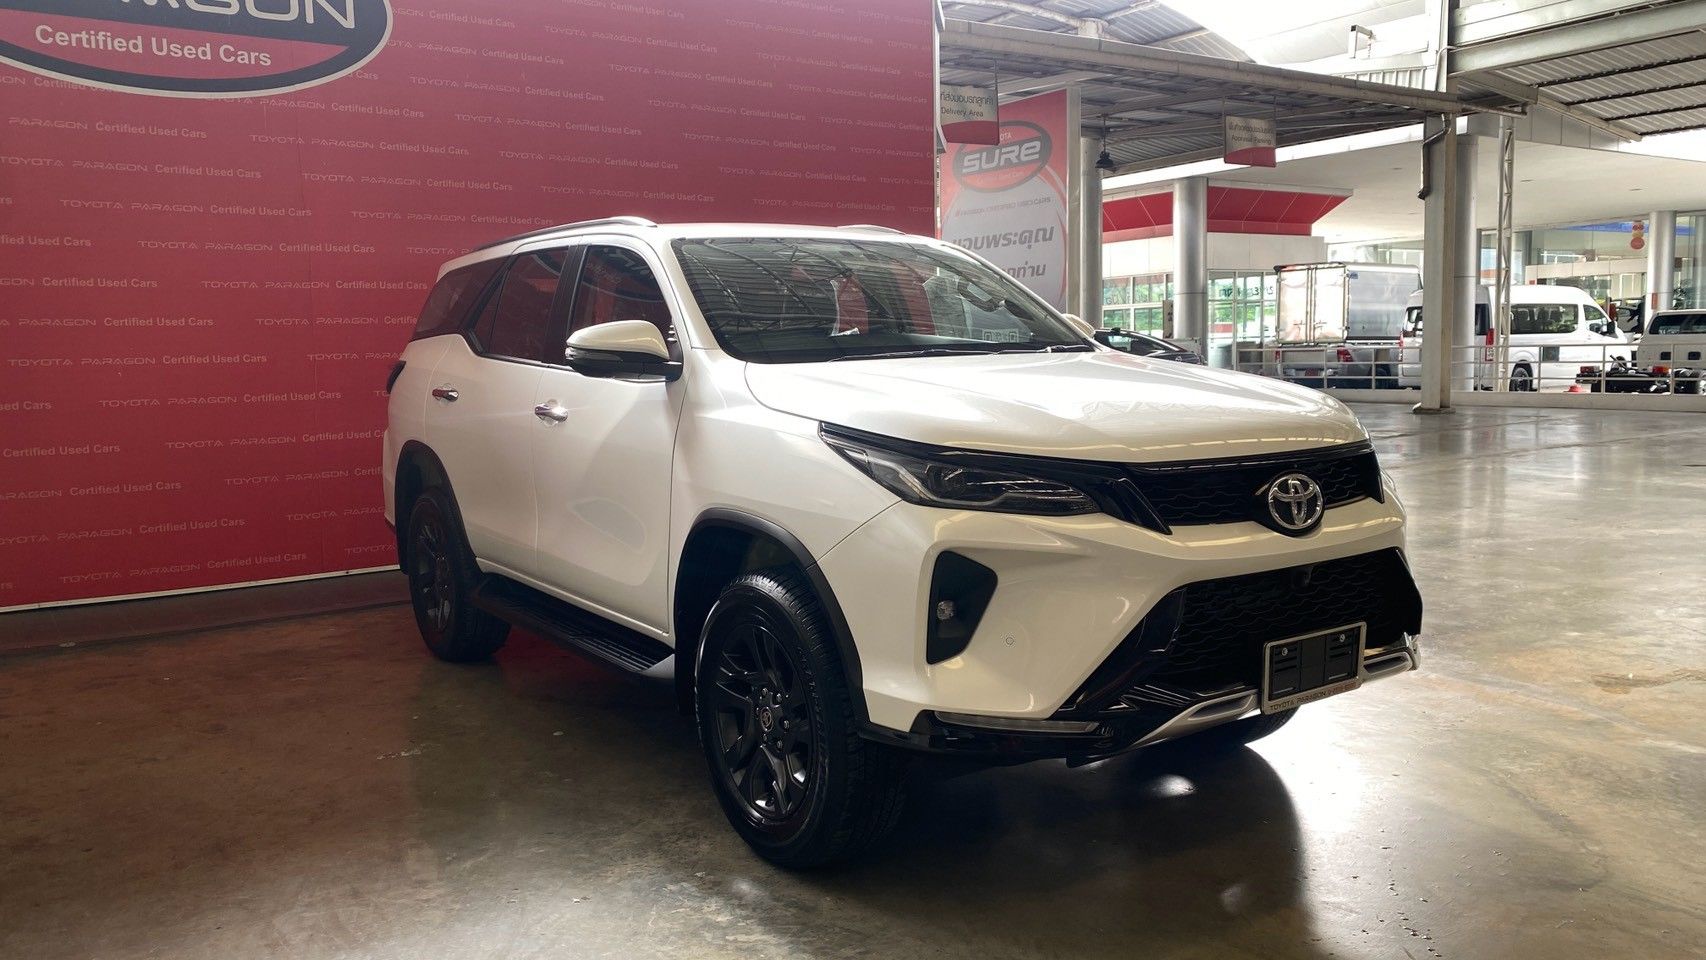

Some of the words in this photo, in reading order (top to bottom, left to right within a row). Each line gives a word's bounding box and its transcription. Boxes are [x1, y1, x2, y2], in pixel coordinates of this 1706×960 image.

[35, 25, 143, 54] Certified
[151, 37, 211, 61] Used
[219, 44, 272, 67] Cars
[8, 117, 88, 129] PARAGON
[95, 121, 145, 134] Certified
[149, 126, 178, 136] Used
[180, 128, 207, 138] Cars
[248, 134, 306, 144] TOYOTA
[310, 138, 374, 148] PARAGON
[379, 141, 420, 152] Certified
[421, 145, 445, 153] Used
[447, 146, 470, 155] Cars
[0, 156, 65, 166] TOYOTA
[71, 160, 149, 172] PARAGON
[154, 163, 201, 175] Certified
[205, 167, 234, 177] Used
[236, 169, 262, 178] Cars
[301, 172, 355, 182] TOYOTA
[359, 175, 422, 185] PARAGON
[425, 178, 466, 188] Certified
[467, 181, 490, 189] Used
[492, 182, 513, 190] Cars
[59, 199, 124, 209] TOYOTA
[130, 202, 204, 212] PARAGON
[210, 204, 257, 215] Certified
[258, 207, 286, 216] Used
[287, 207, 313, 217] Cars
[350, 210, 401, 219] TOYOTA
[406, 213, 466, 221] PARAGON
[469, 214, 509, 223] Certified
[509, 216, 532, 224] Used
[533, 217, 554, 225] Cars
[28, 236, 60, 246] Used
[63, 237, 92, 246] Cars
[135, 240, 200, 249] TOYOTA
[204, 242, 273, 251] PARAGON
[279, 242, 321, 252] Certified
[324, 243, 350, 252] Used
[352, 244, 375, 253] Cars
[41, 276, 94, 287] Certified
[97, 278, 128, 287] Used
[130, 278, 158, 287] Cars
[200, 280, 259, 288] TOYOTA
[334, 280, 376, 288] Certified
[378, 281, 403, 289] Used
[405, 281, 428, 289] Cars
[18, 318, 97, 326] PARAGON
[102, 316, 153, 326] Certified
[156, 317, 186, 326] Used
[253, 317, 310, 325] TOYOTA
[314, 316, 379, 324] PARAGON
[6, 358, 73, 366] TOYOTA
[80, 356, 156, 365] PARAGON
[161, 354, 210, 364] Certified
[211, 355, 240, 363] Used
[242, 354, 268, 362] Cars
[305, 352, 360, 360] TOYOTA
[22, 399, 52, 410] Cars
[98, 398, 160, 407] TOYOTA
[166, 395, 239, 405] PARAGON
[242, 392, 288, 402] Certified
[290, 391, 316, 401] Used
[317, 390, 341, 399] Cars
[164, 439, 224, 449] TOYOTA
[229, 435, 296, 446] PARAGON
[301, 431, 344, 441] Certified
[346, 430, 371, 439] Used
[2, 446, 56, 457] Certified
[59, 445, 90, 455] Used
[92, 444, 120, 453] Cars
[223, 474, 279, 485] TOYOTA
[285, 470, 349, 481] PARAGON
[69, 484, 120, 496] Certified
[123, 483, 152, 492] Used
[155, 480, 182, 490] Cars
[286, 510, 338, 521] TOYOTA
[56, 527, 132, 540] PARAGON
[139, 521, 187, 533] Certified
[189, 519, 218, 529] Used
[219, 517, 246, 527] Cars
[58, 570, 120, 583] TOYOTA
[129, 563, 201, 576] PARAGON
[206, 556, 252, 569] Certified
[254, 554, 281, 564] Used
[283, 552, 307, 561] Cars
[1270, 700, 1296, 711] TOYOTA
